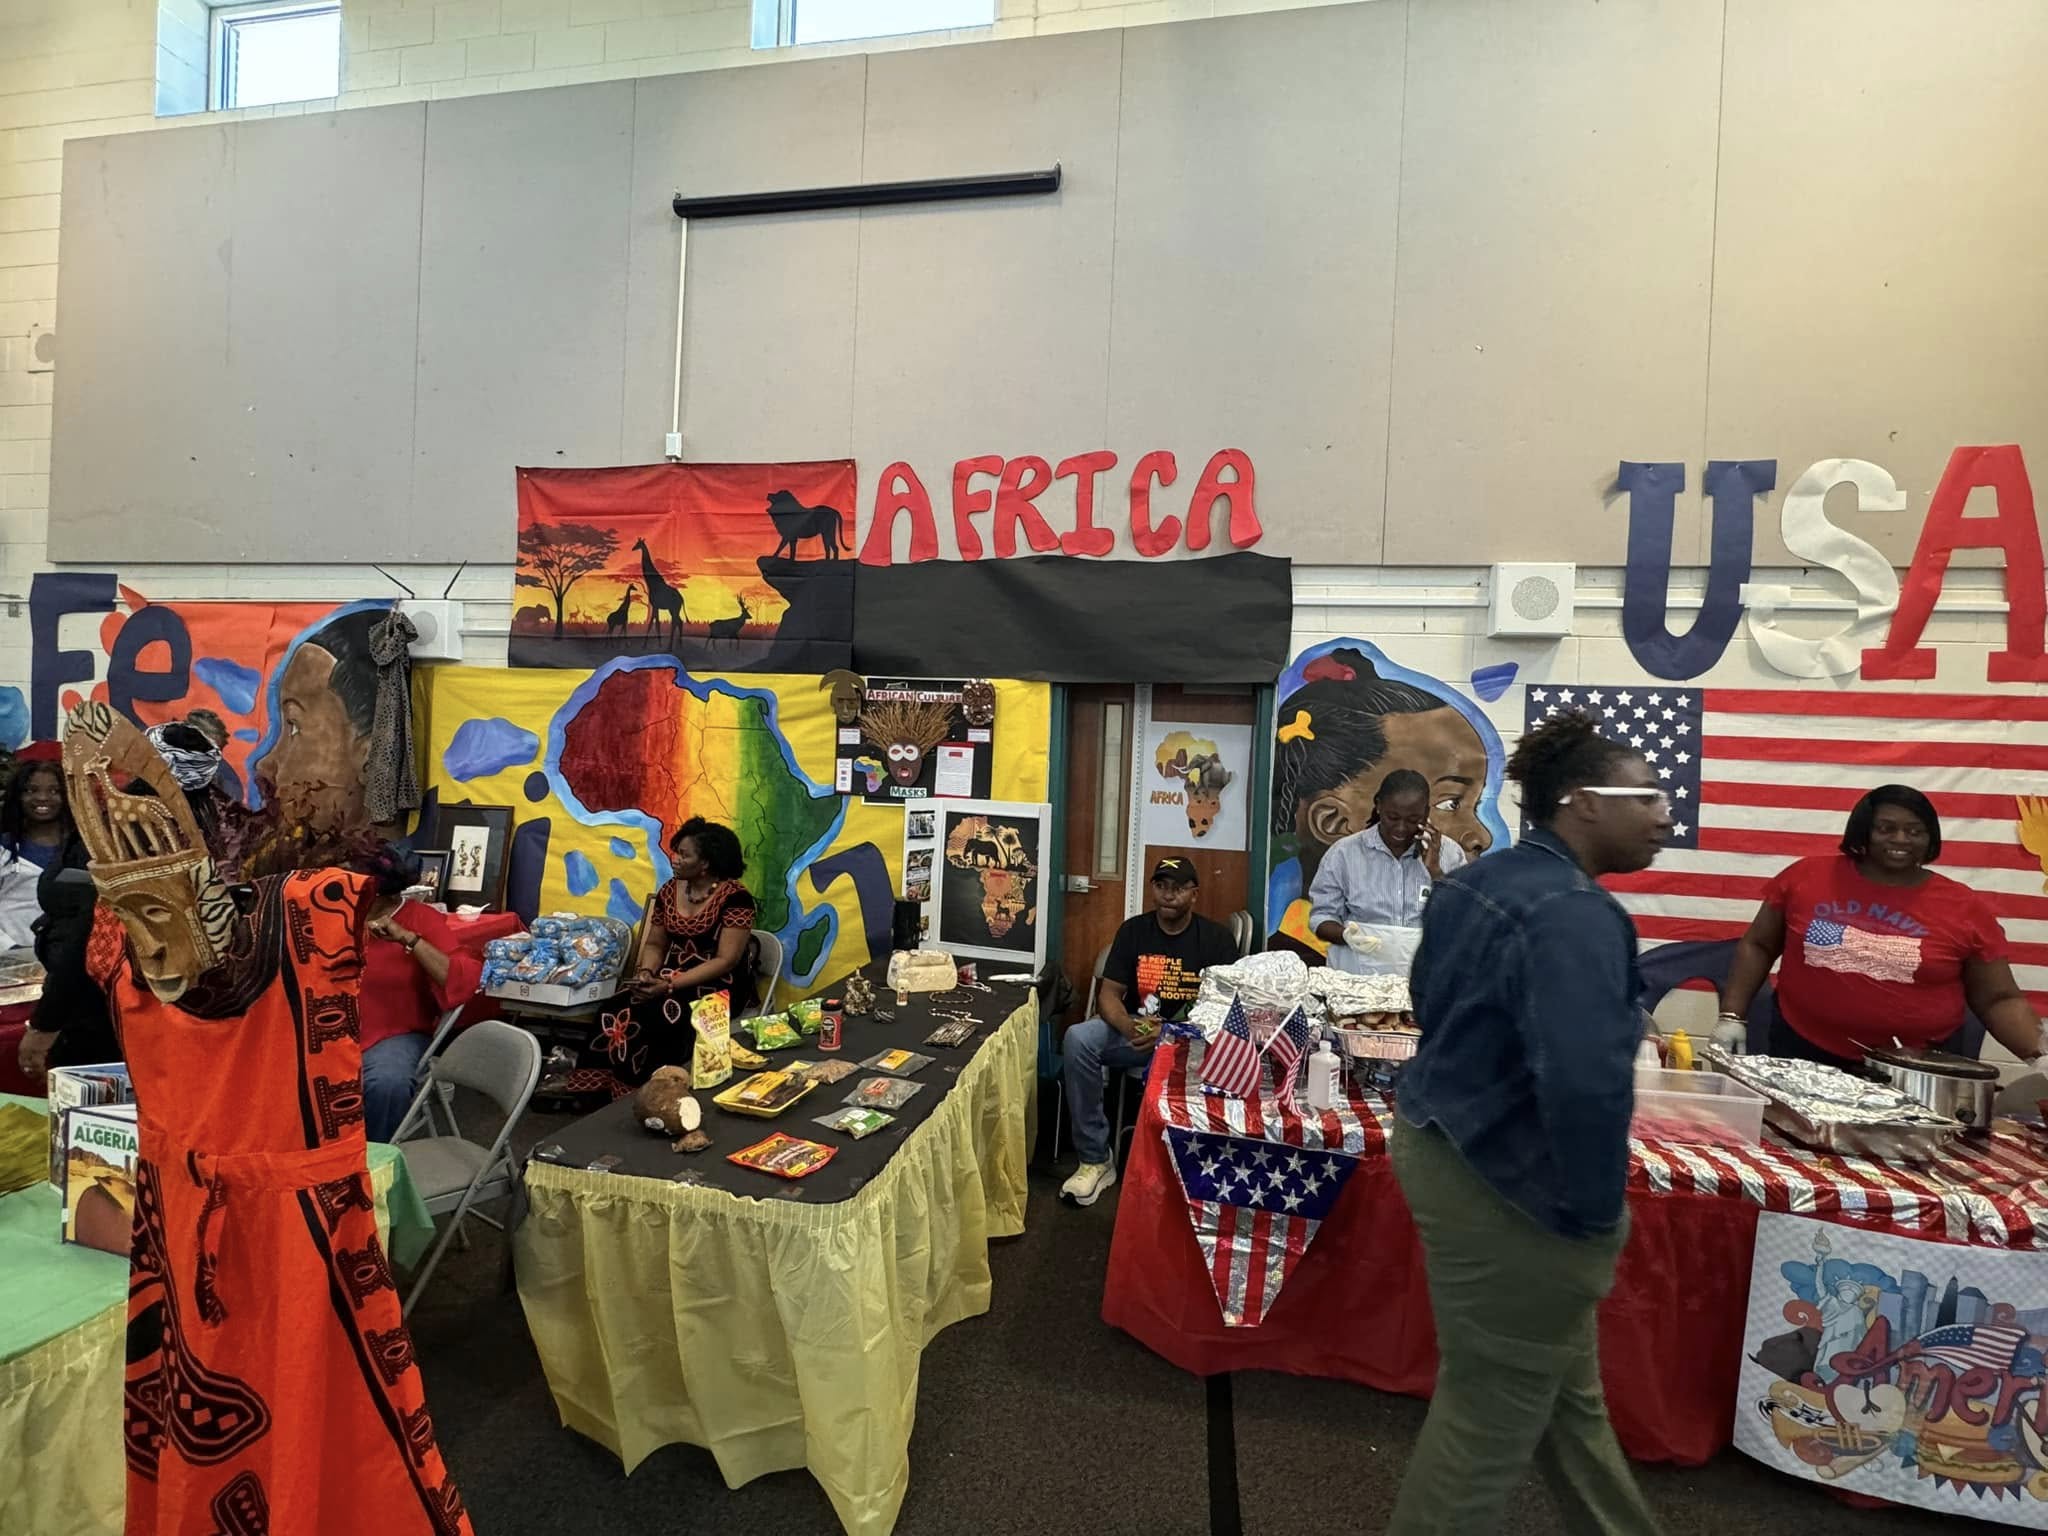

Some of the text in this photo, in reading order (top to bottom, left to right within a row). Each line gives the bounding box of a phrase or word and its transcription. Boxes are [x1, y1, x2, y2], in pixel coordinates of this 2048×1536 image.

[858, 448, 1263, 567] AFRICA
[1616, 444, 2048, 683] USA
[867, 689, 962, 703] AFRICAN CULTURE
[891, 786, 926, 798] MASKS
[1151, 790, 1184, 806] AFRICA
[1814, 899, 1929, 937] OLD NAVY
[1149, 956, 1182, 966] PEOPLE
[74, 1125, 139, 1153] ALGERIA
